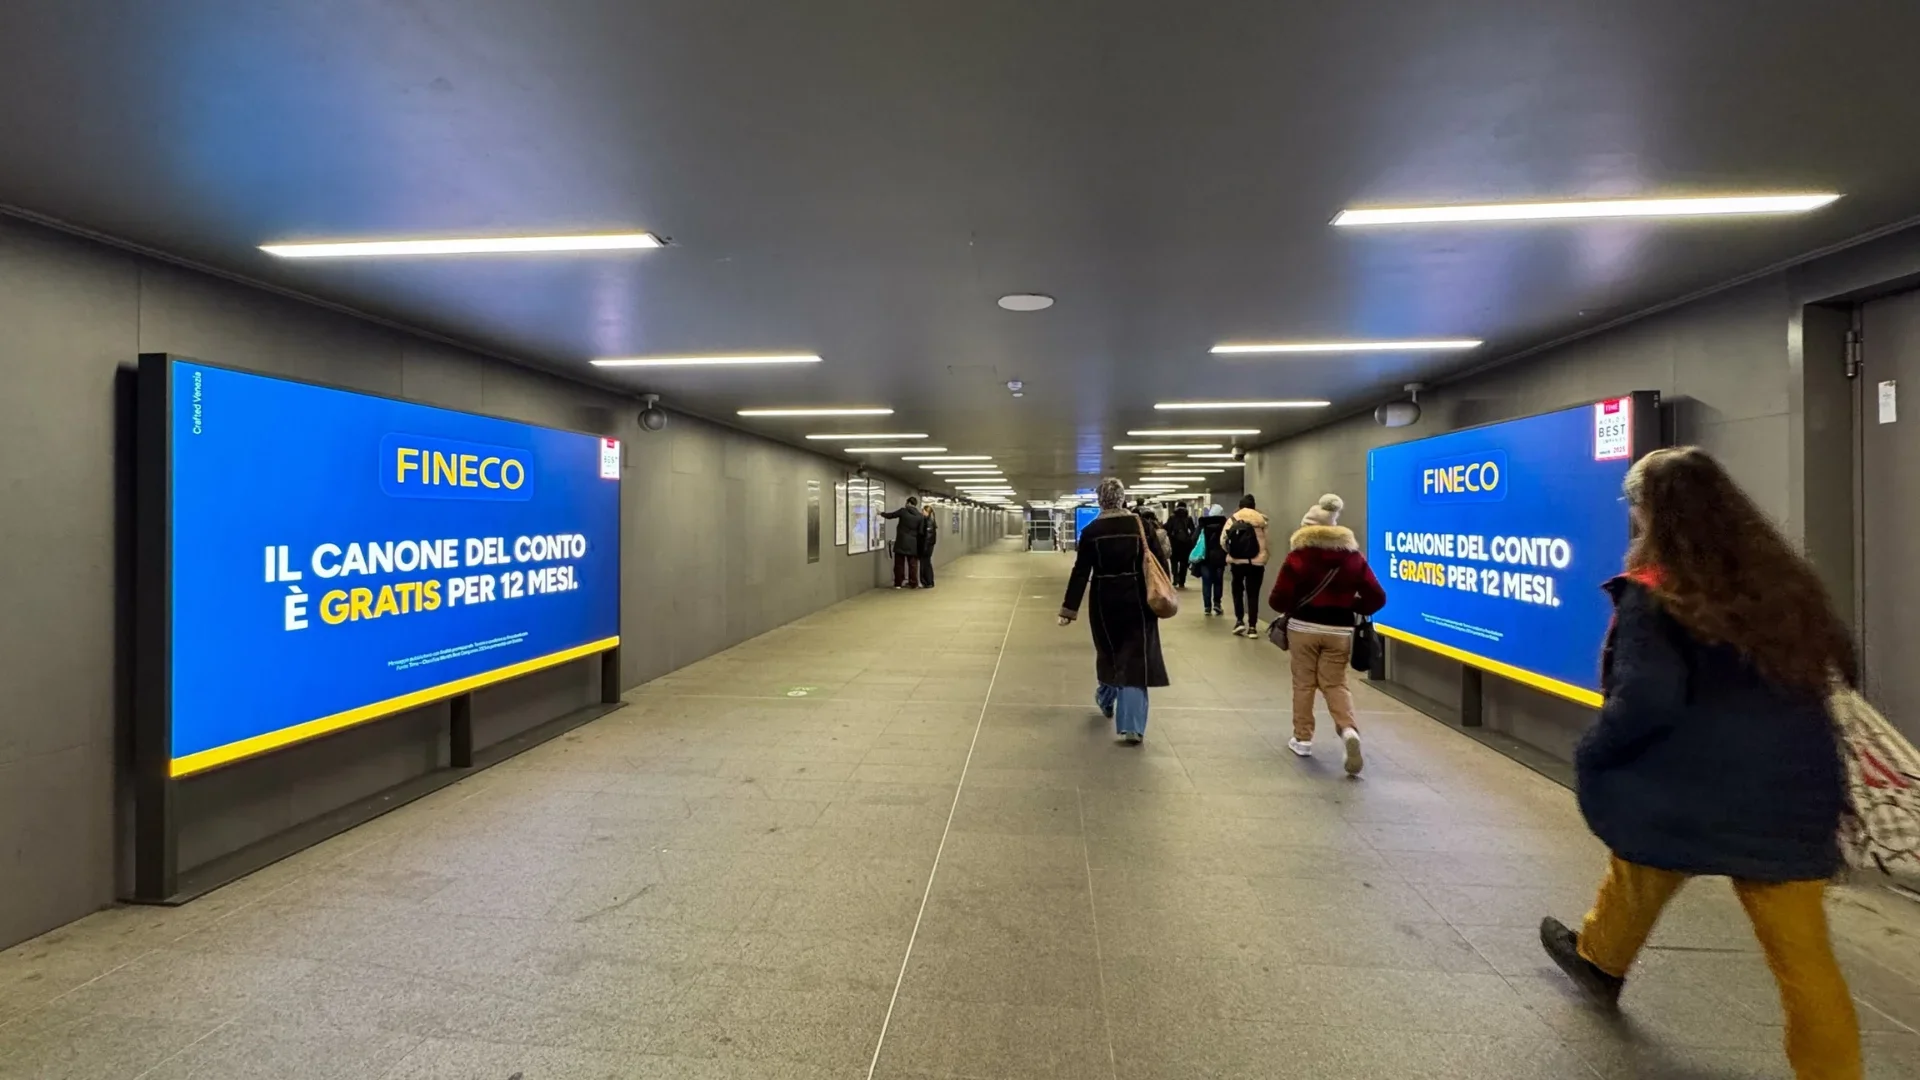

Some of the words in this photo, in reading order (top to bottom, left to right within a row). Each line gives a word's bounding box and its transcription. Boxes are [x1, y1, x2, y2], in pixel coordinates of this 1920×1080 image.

[192, 371, 202, 402] Venezia
[192, 404, 202, 434] Crafted
[1598, 423, 1625, 437] BEST
[397, 447, 525, 490] FINECO
[1423, 461, 1499, 494] FINECO
[265, 545, 302, 583] IL
[311, 538, 459, 579] CANONE
[465, 536, 511, 567] DEL
[514, 533, 586, 563] CONTO
[1385, 531, 1396, 552] IL
[1396, 532, 1455, 558] CANONE
[1456, 534, 1489, 561] DEL
[1490, 535, 1572, 569] CONTO
[285, 585, 309, 631] È
[319, 580, 442, 625] GRATIS
[448, 574, 496, 607] PER
[499, 570, 524, 599] 12
[527, 565, 579, 596] MESI.
[1389, 553, 1398, 579] È
[1398, 559, 1446, 587] GRATIS
[1446, 564, 1478, 593] PER
[1480, 568, 1501, 597] 12
[1502, 571, 1561, 607] MESI.
